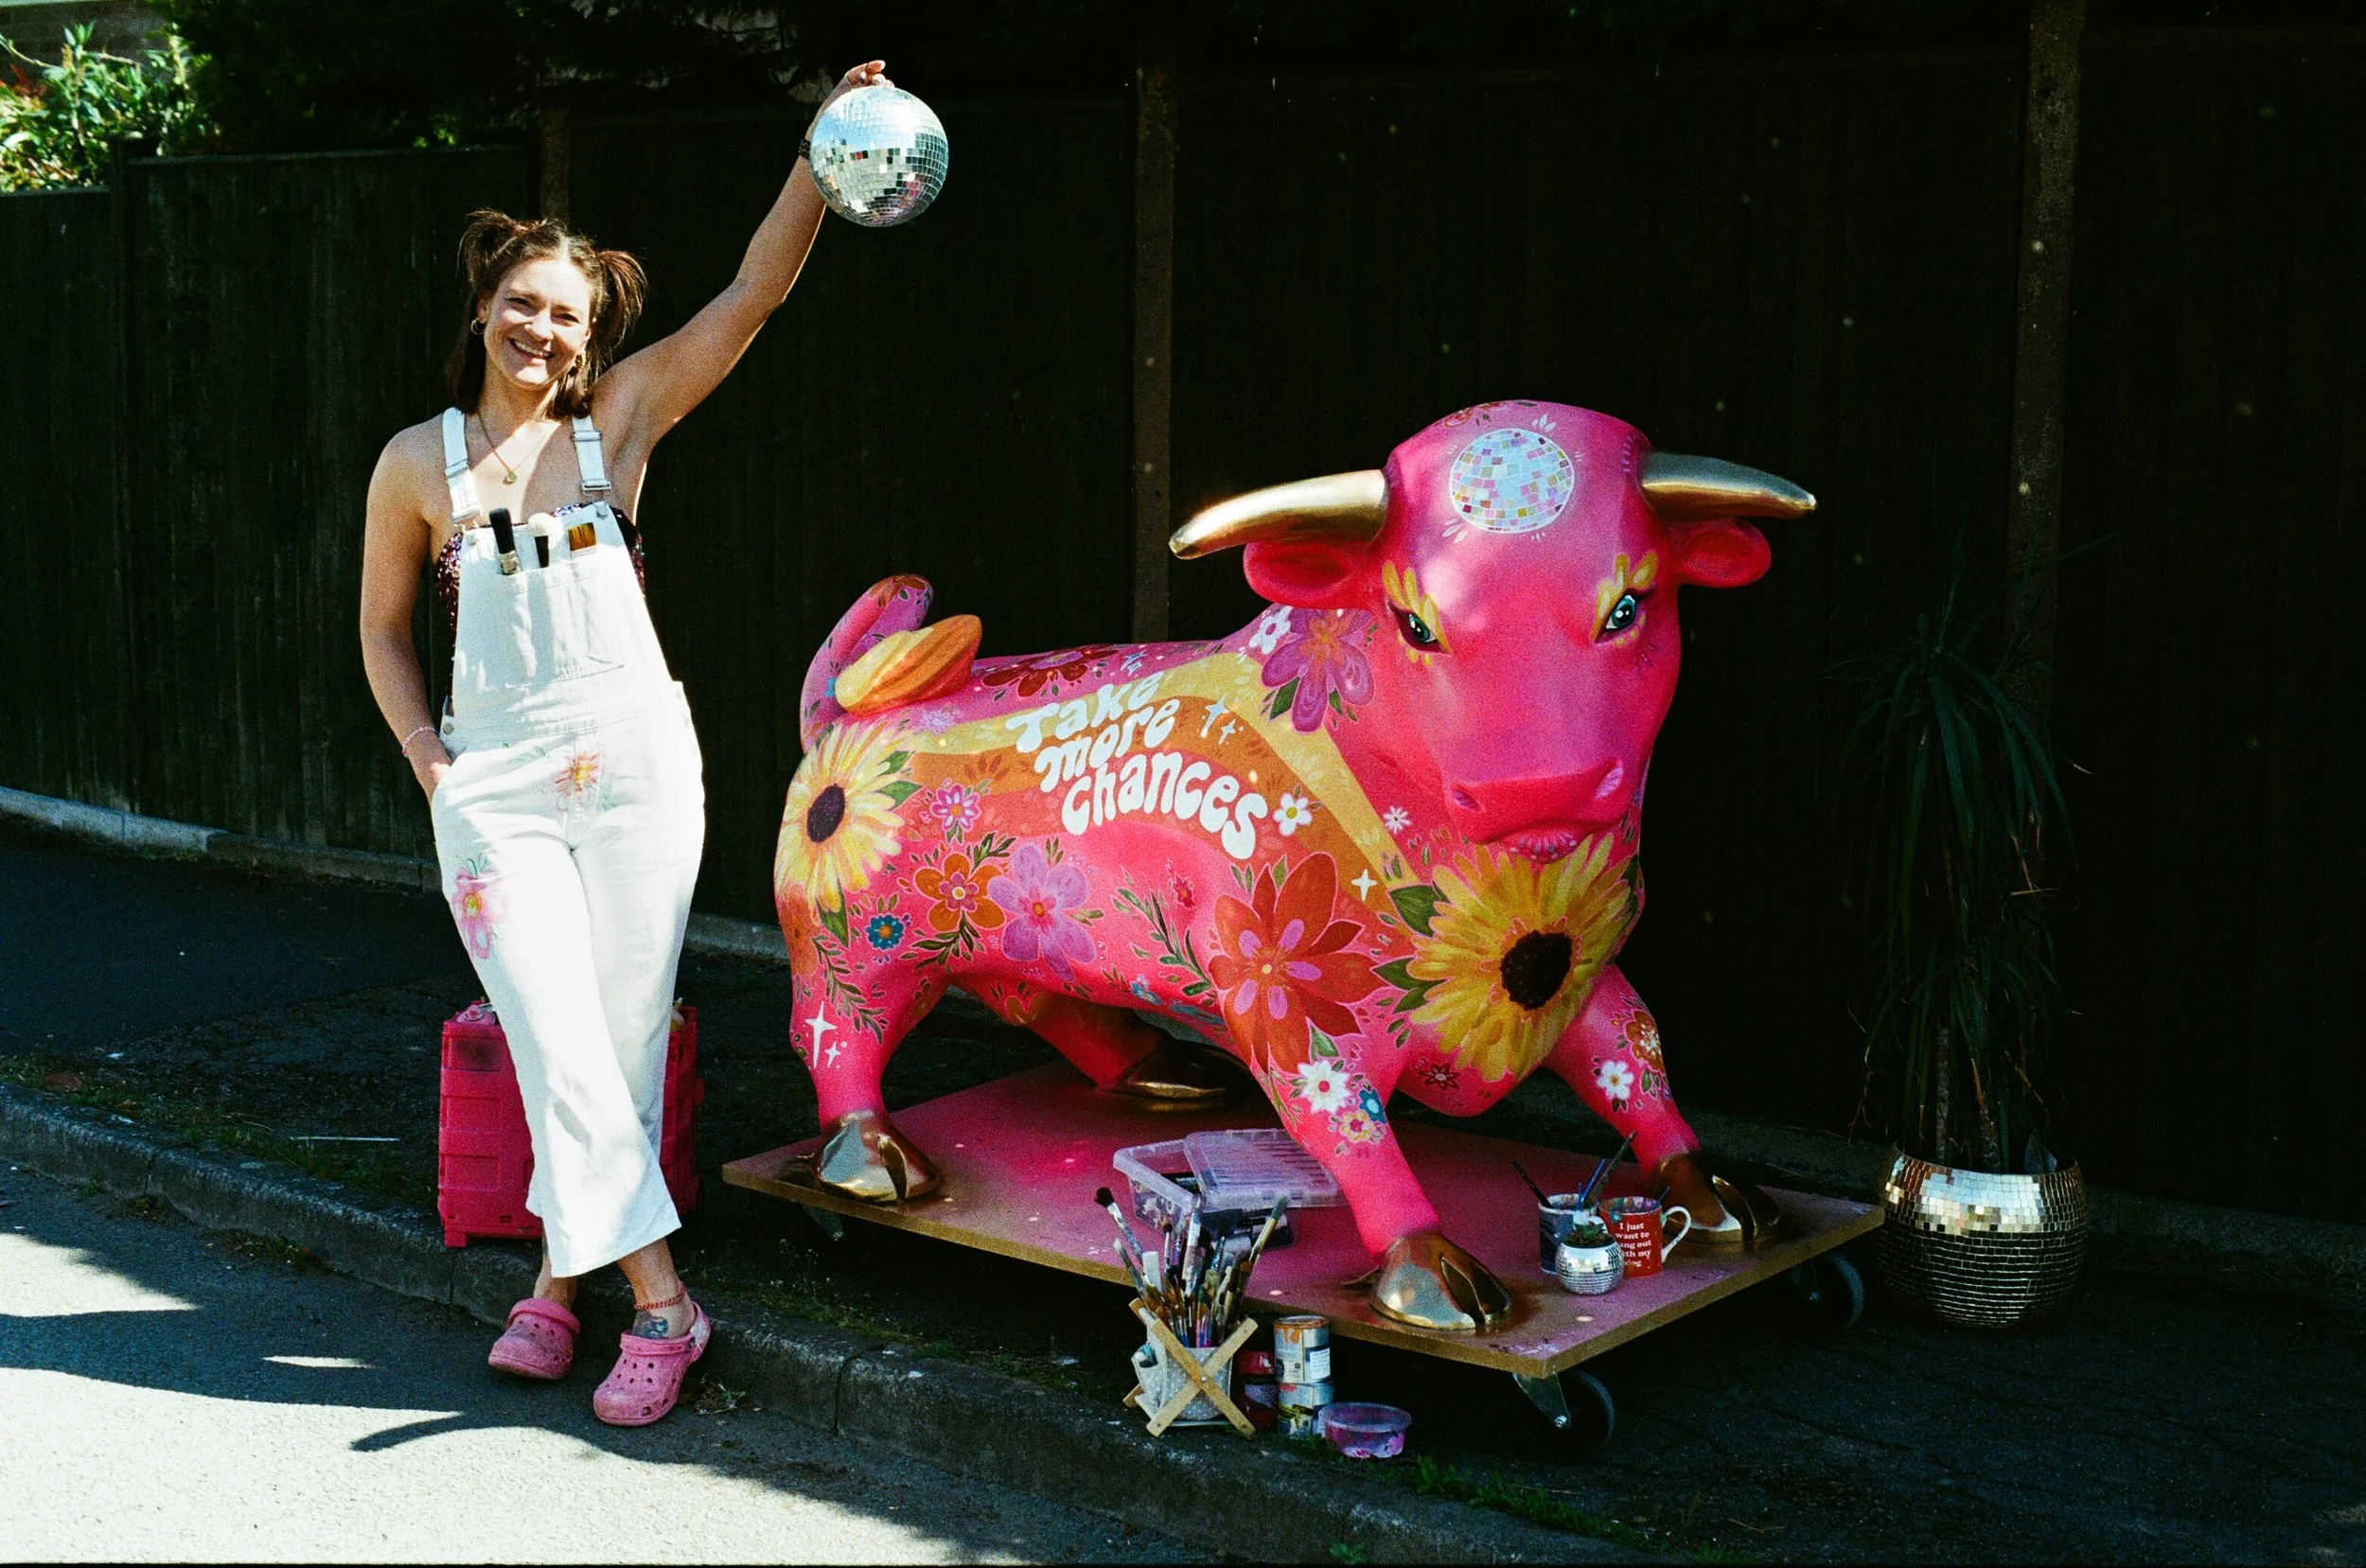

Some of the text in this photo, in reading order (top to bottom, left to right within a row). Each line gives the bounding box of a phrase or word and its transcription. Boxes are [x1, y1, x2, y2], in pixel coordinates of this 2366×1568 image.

[1033, 698, 1180, 793] more
[1626, 1222, 1644, 1232] just
[1636, 1240, 1651, 1248] out
[1637, 1249, 1651, 1259] my
